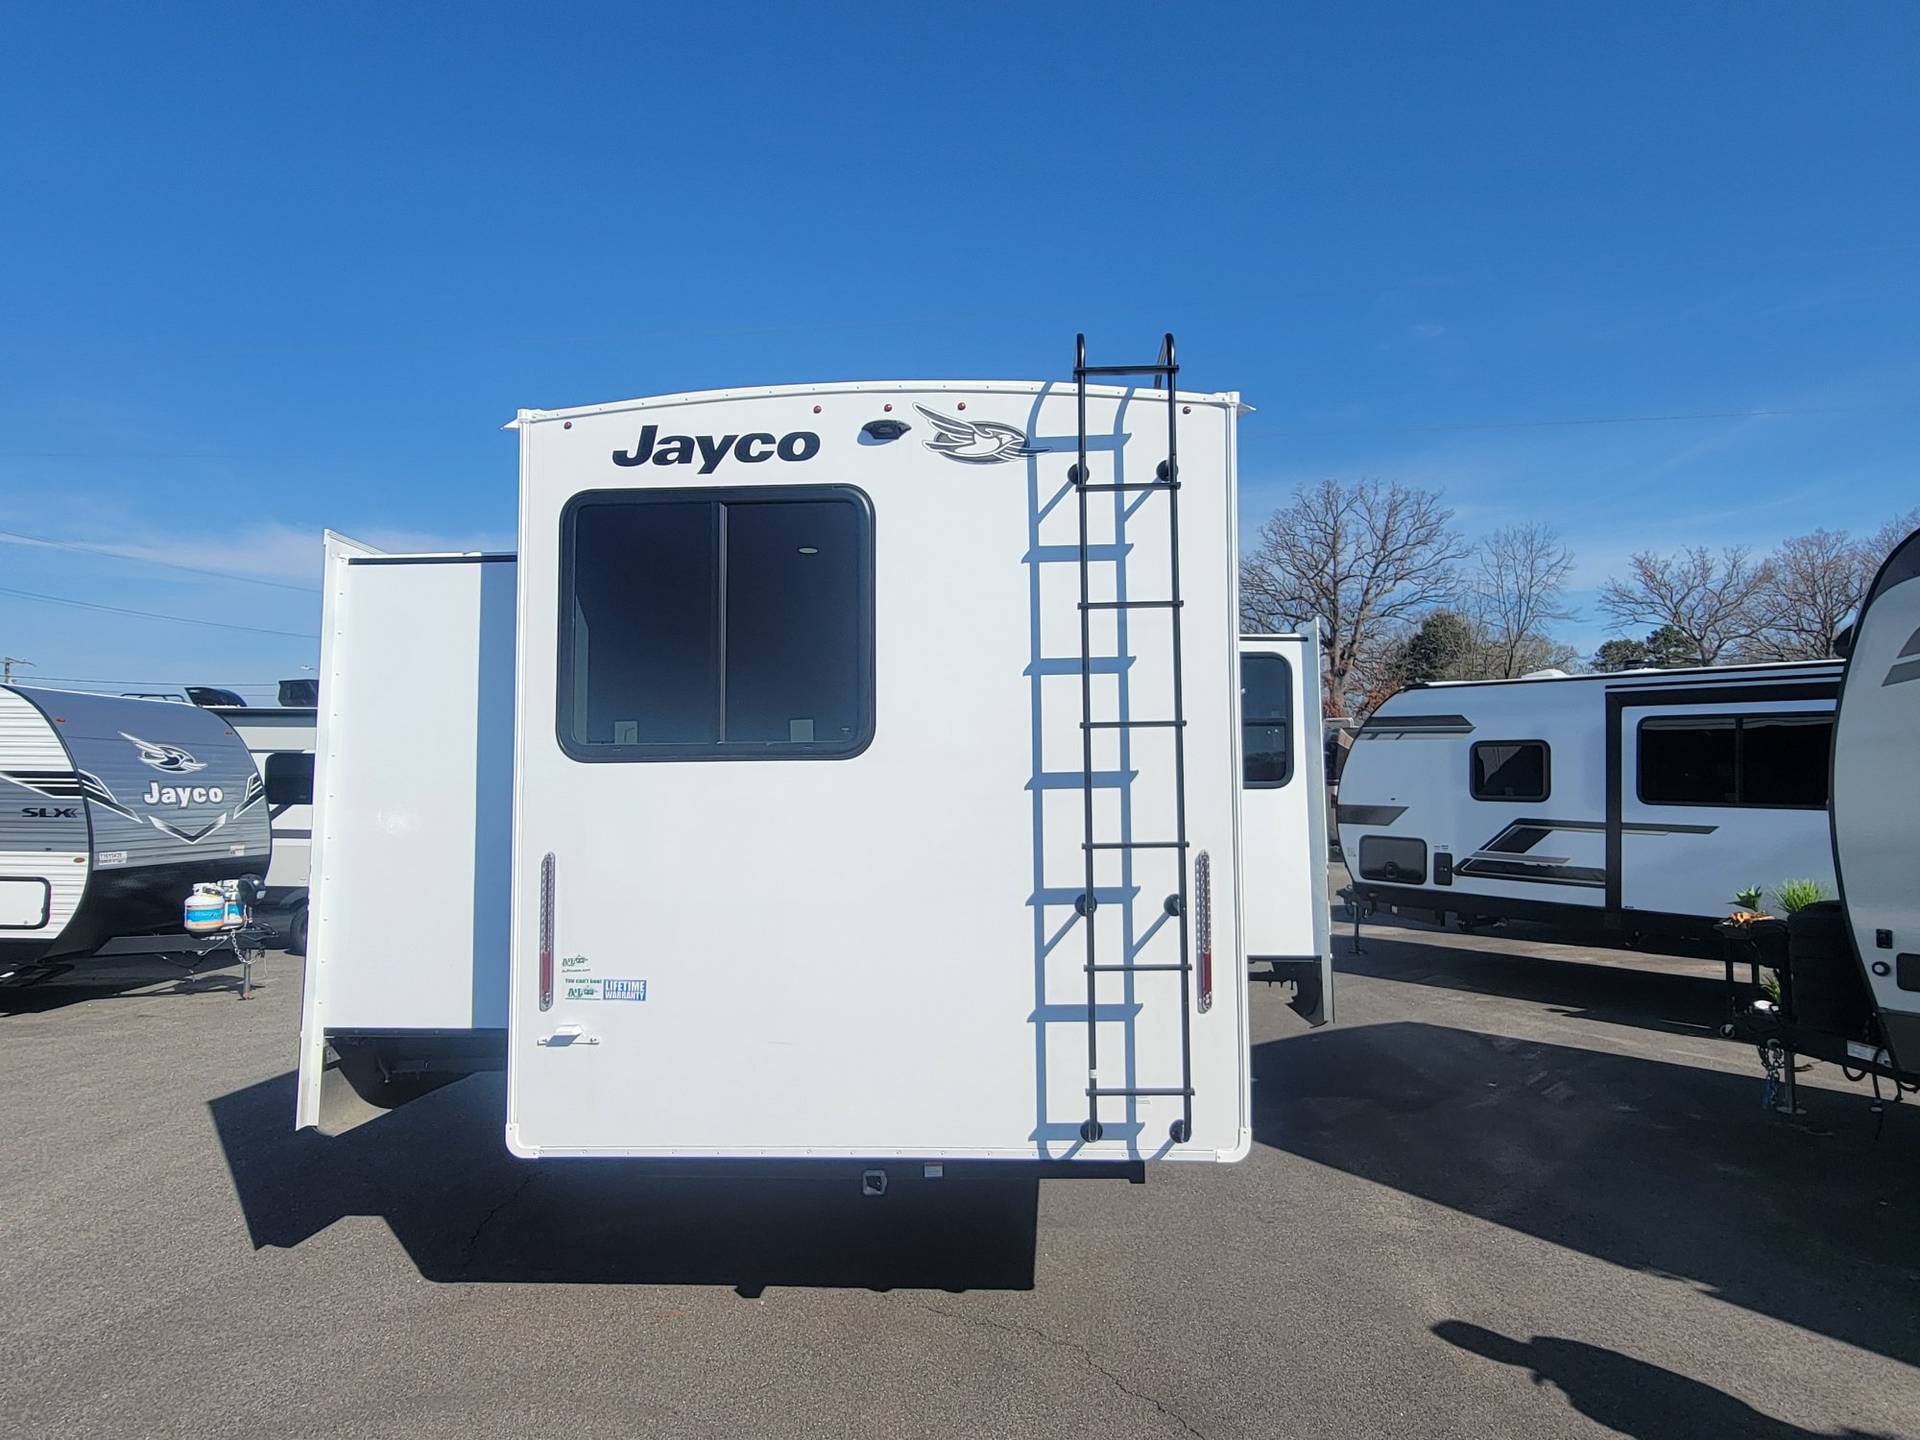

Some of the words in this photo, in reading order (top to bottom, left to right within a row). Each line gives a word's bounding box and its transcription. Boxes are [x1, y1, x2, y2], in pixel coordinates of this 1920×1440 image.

[612, 424, 820, 475] Jayco
[143, 781, 224, 808] Jayco
[21, 807, 74, 818] SLX
[605, 981, 645, 992] LIFETIME
[605, 991, 645, 1001] WARRANTY
